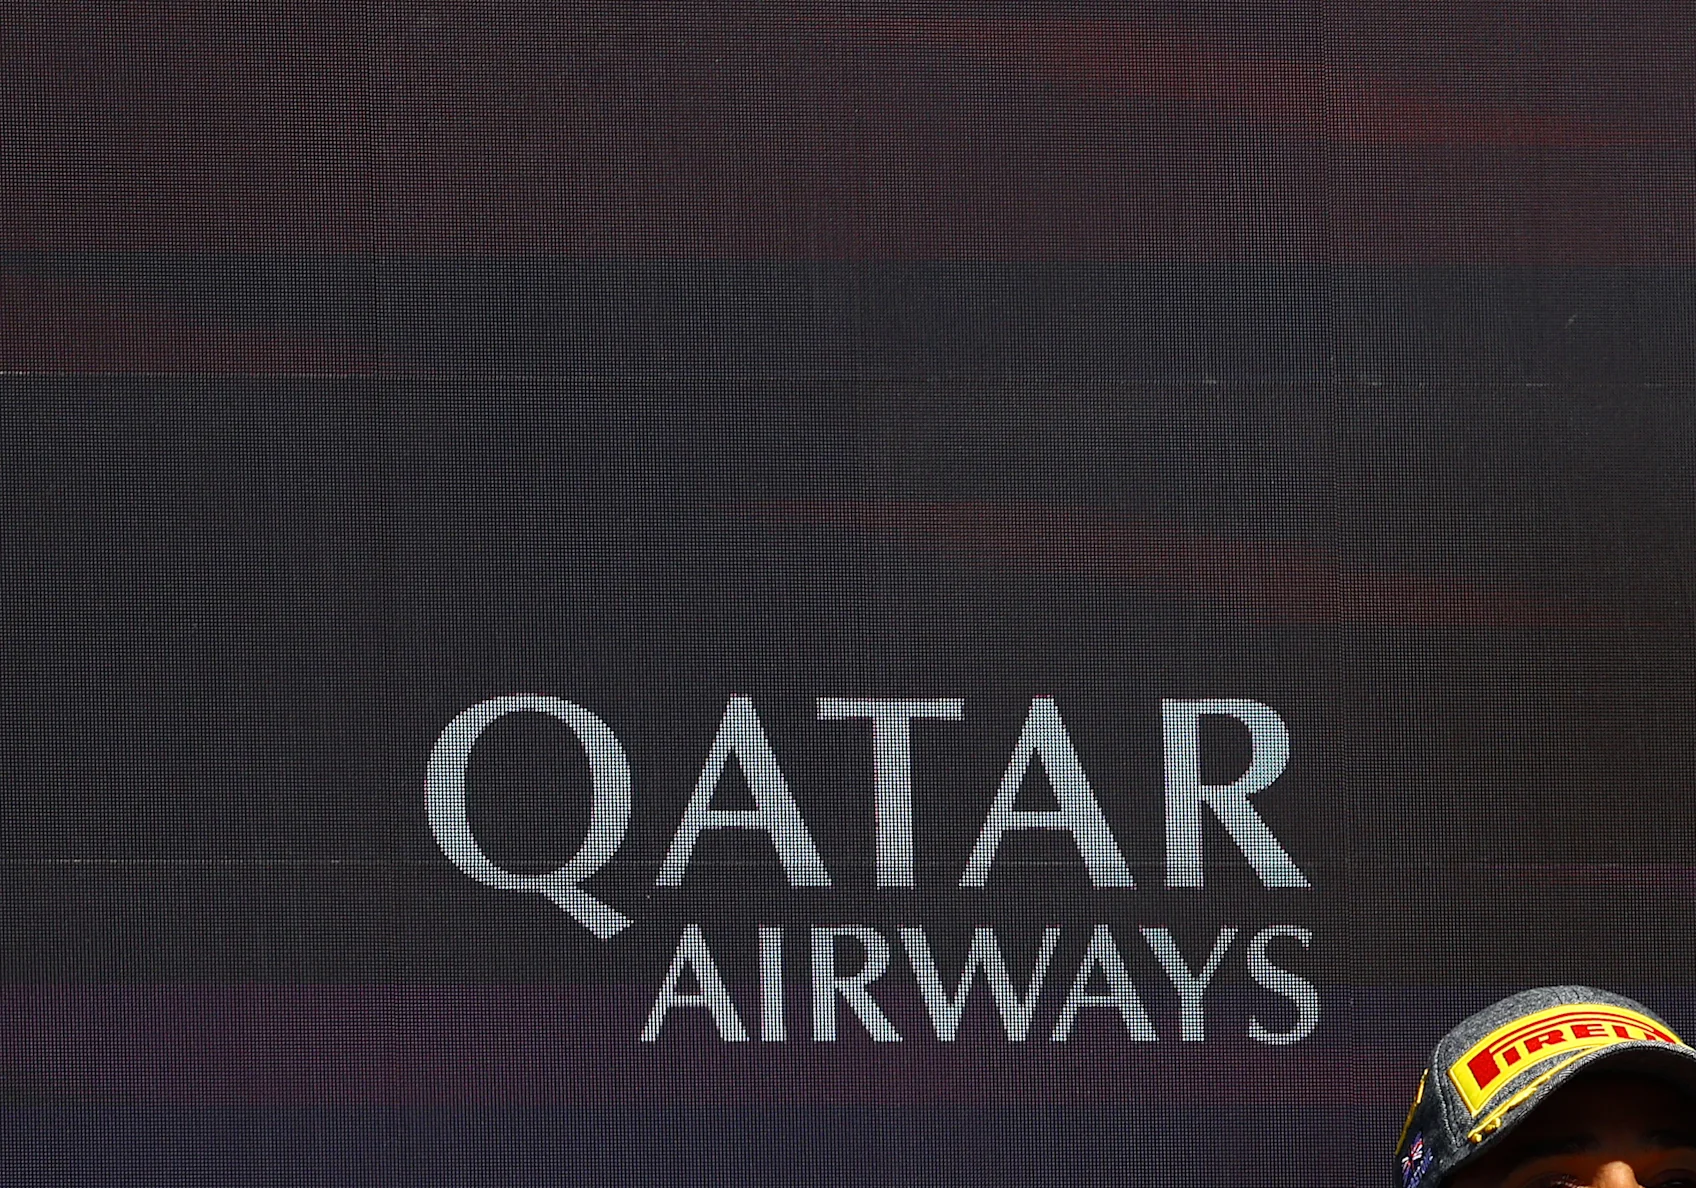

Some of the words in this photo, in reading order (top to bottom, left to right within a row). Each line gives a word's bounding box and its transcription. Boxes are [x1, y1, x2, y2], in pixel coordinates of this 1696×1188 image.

[424, 693, 1312, 938] QATAR
[638, 923, 1322, 1046] AIRWAYS
[1467, 1012, 1677, 1090] PIREL
